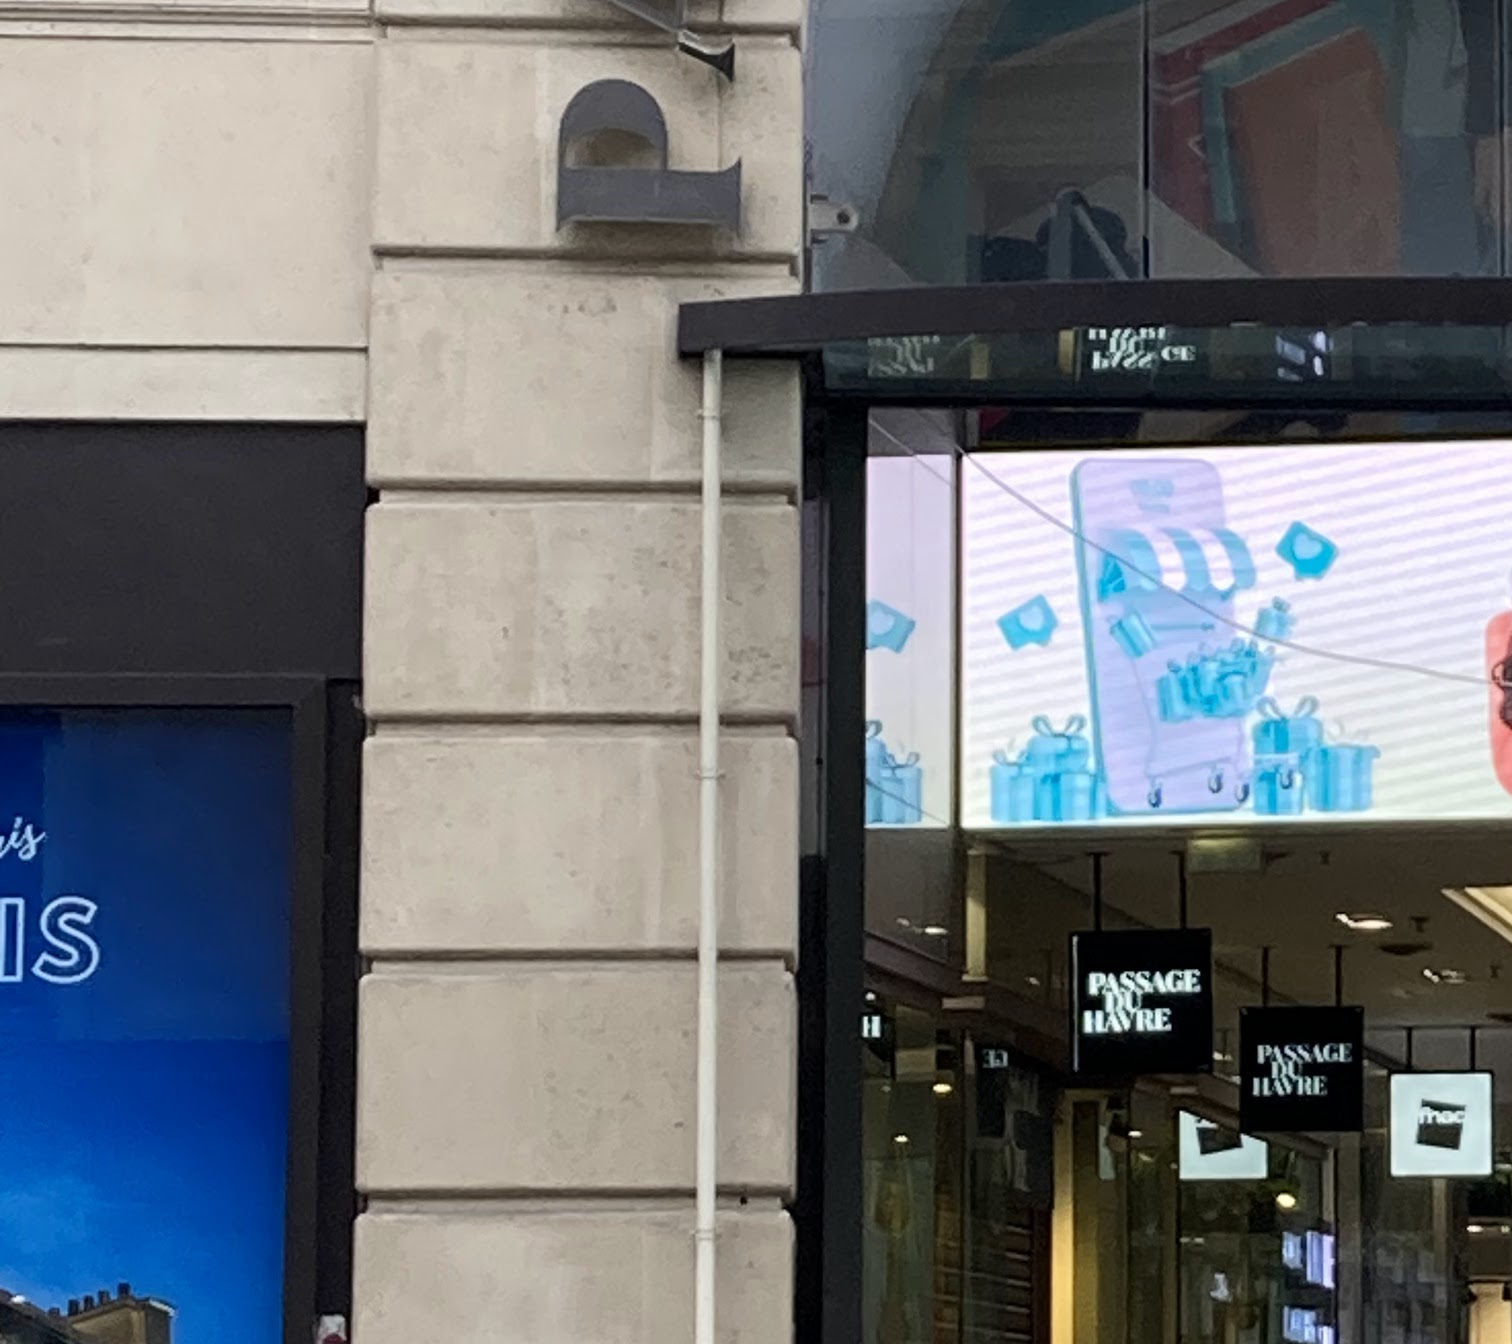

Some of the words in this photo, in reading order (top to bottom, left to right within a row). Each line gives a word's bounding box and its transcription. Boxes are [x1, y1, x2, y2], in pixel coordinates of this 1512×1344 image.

[1088, 969, 1202, 996] PASSAGE
[1104, 990, 1142, 1014] DU
[1082, 1007, 1172, 1034] HAVRE
[1257, 1043, 1352, 1064] PASSAGE
[1271, 1060, 1303, 1080] DU
[1252, 1075, 1328, 1097] HAVRE
[1418, 1106, 1466, 1125] fnac
